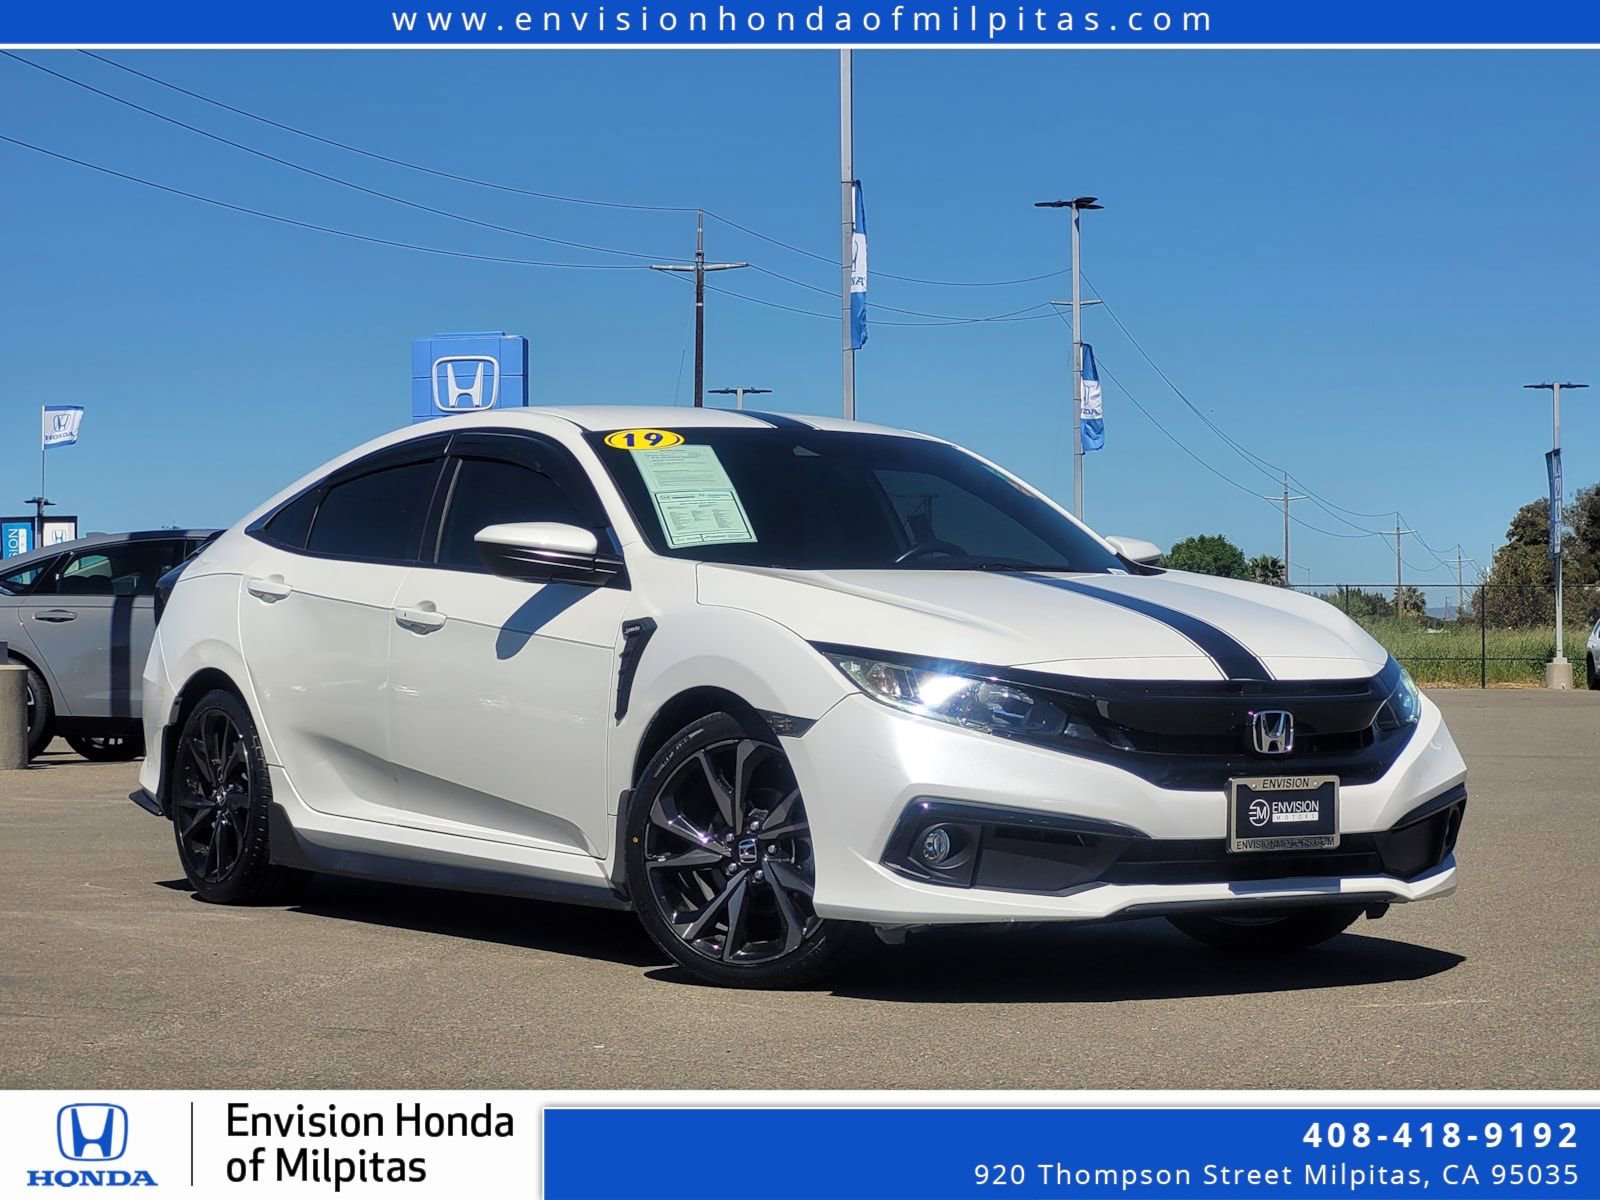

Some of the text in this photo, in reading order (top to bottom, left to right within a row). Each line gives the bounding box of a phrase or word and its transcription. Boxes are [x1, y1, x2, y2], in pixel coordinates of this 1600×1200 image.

[623, 432, 664, 447] 19
[1262, 778, 1310, 789] ENVISION
[1272, 800, 1320, 814] ENVISION
